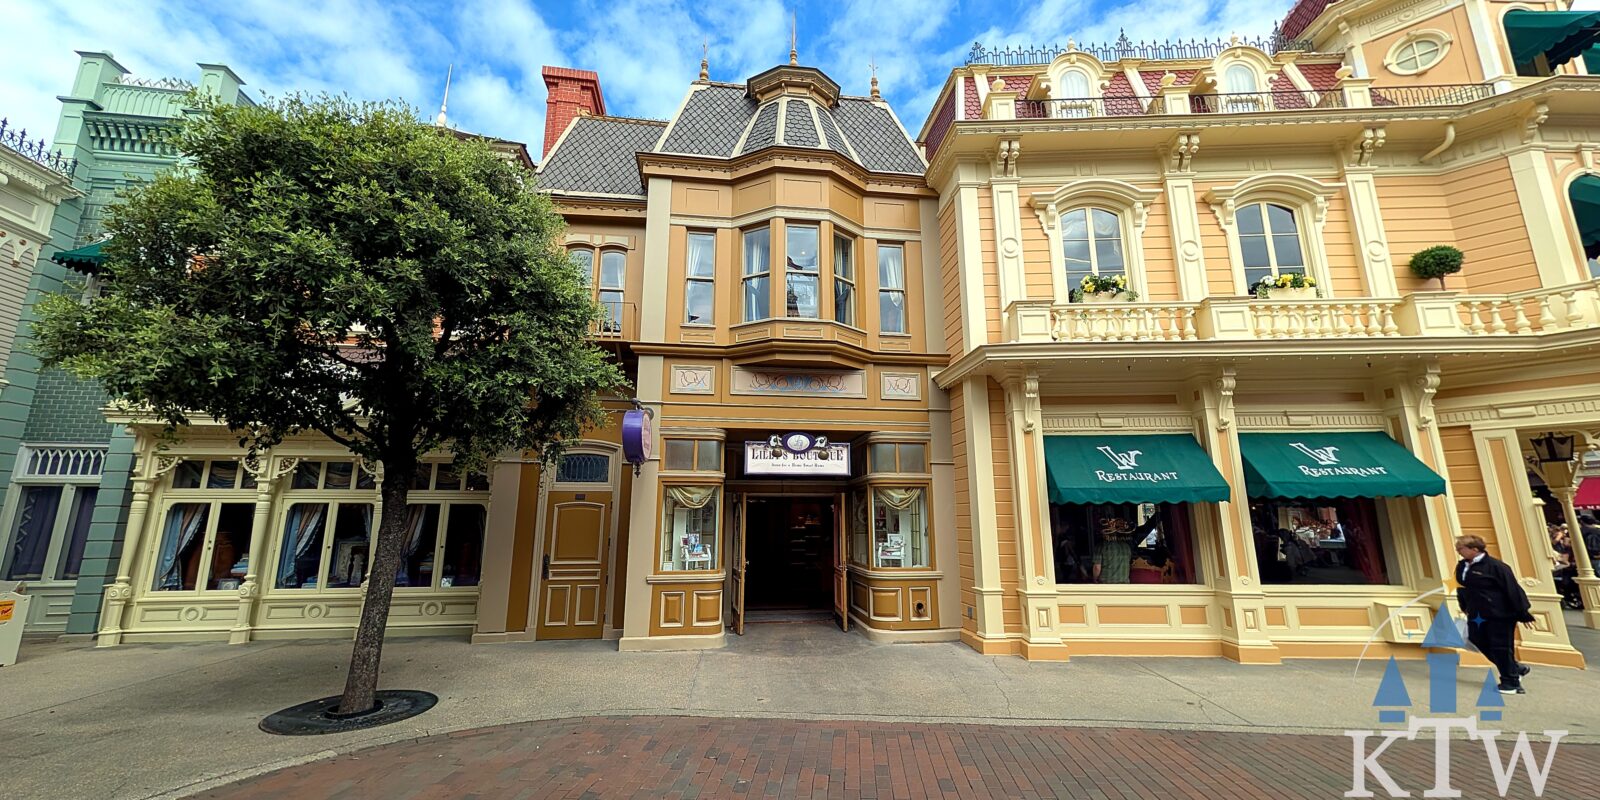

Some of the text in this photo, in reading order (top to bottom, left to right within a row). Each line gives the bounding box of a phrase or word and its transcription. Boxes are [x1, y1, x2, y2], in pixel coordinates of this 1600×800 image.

[751, 448, 843, 461] LILLS BOUTUE
[1095, 470, 1178, 483] RESTAURANT
[1298, 465, 1388, 477] RESTAURANT
